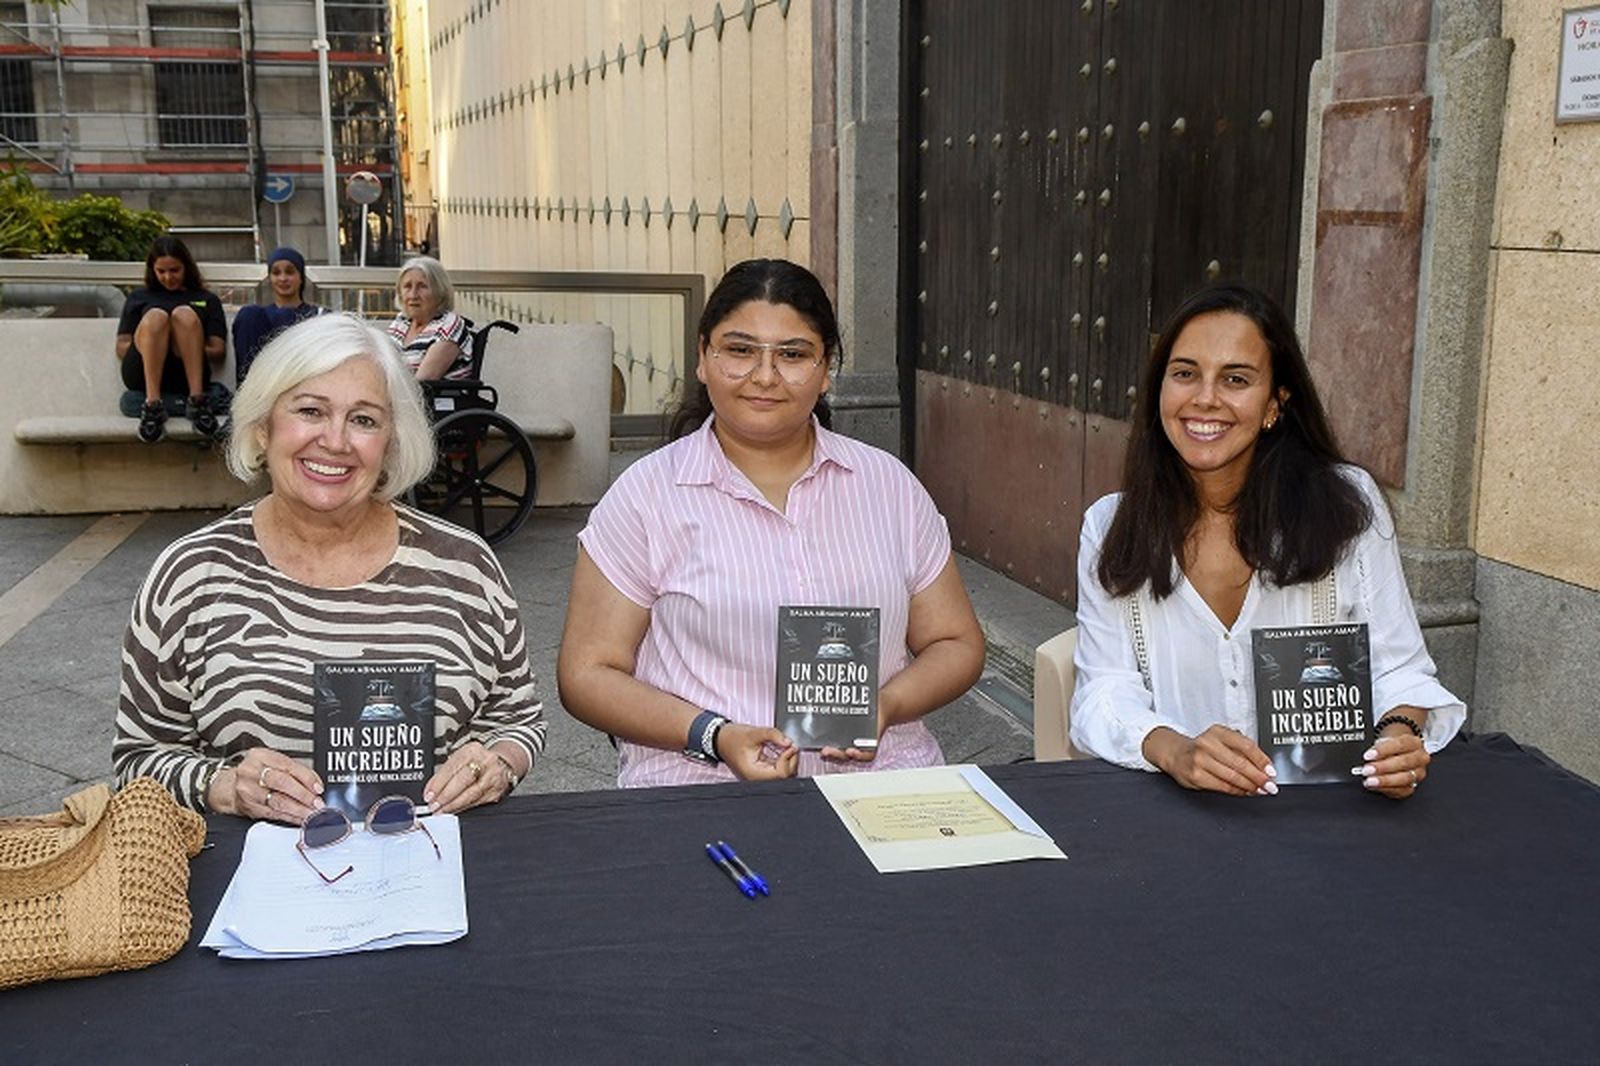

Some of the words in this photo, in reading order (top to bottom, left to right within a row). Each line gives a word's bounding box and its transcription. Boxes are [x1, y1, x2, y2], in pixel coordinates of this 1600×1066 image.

[791, 662, 811, 681] UN
[817, 661, 868, 683] SUEÑO
[787, 682, 870, 705] INCREÍBLE
[1272, 689, 1296, 710] UN
[1303, 683, 1360, 709] SUEÑO
[1271, 707, 1365, 733] INCREÍBLE
[329, 727, 354, 747] UN
[361, 723, 421, 747] SUEÑO
[327, 747, 424, 771] INCREÍBLE
